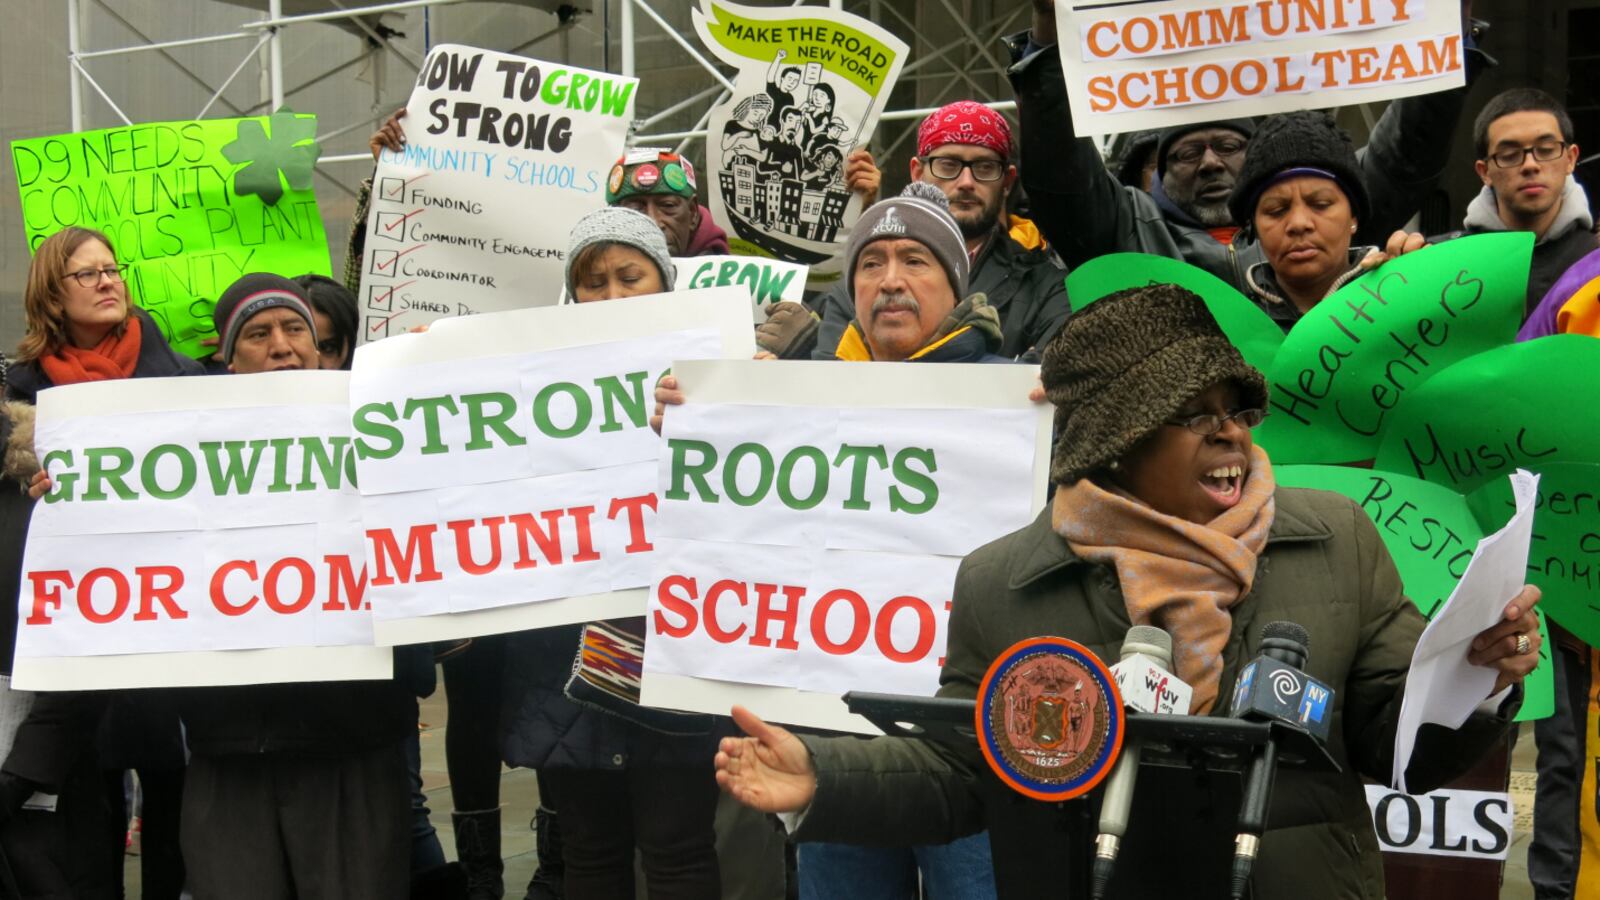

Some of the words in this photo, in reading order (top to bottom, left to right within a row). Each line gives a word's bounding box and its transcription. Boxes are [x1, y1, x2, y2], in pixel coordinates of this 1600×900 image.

[727, 22, 782, 43] MAKE
[787, 26, 828, 42] THE
[832, 31, 887, 68] ROAD
[1086, 0, 1411, 58] COMMUNITY
[496, 60, 541, 102] TO
[540, 69, 635, 117] GROW
[798, 46, 836, 61] NEW
[841, 54, 878, 86] YORK
[1087, 57, 1305, 113] SCHOOL
[1311, 35, 1462, 87] TEAM
[427, 98, 573, 153] STRONG
[13, 139, 72, 187] D9
[82, 123, 205, 178] NEEDS
[381, 144, 497, 177] COMMUNITY
[505, 156, 599, 193] SCHOOLS
[206, 200, 316, 249] PLANT
[412, 189, 483, 214] FUNDING
[410, 222, 487, 251] COMMUNITY
[493, 238, 565, 261] ENGAGEME
[402, 258, 497, 289] COORDINATOR
[689, 260, 798, 305] GROW
[400, 293, 450, 314] SHARED
[1270, 272, 1408, 426] Health
[1336, 269, 1484, 436] Centers
[352, 368, 672, 461] STRON
[665, 438, 939, 515] ROOTS
[1404, 423, 1558, 484] Music
[366, 492, 659, 587] MUNIT
[26, 565, 188, 625] FOR
[209, 554, 372, 617] COM
[653, 574, 951, 667] SCHOO
[1302, 701, 1313, 723] 1
[1308, 685, 1327, 704] NY
[1035, 757, 1061, 767] 1625
[1375, 793, 1509, 854] OLS
